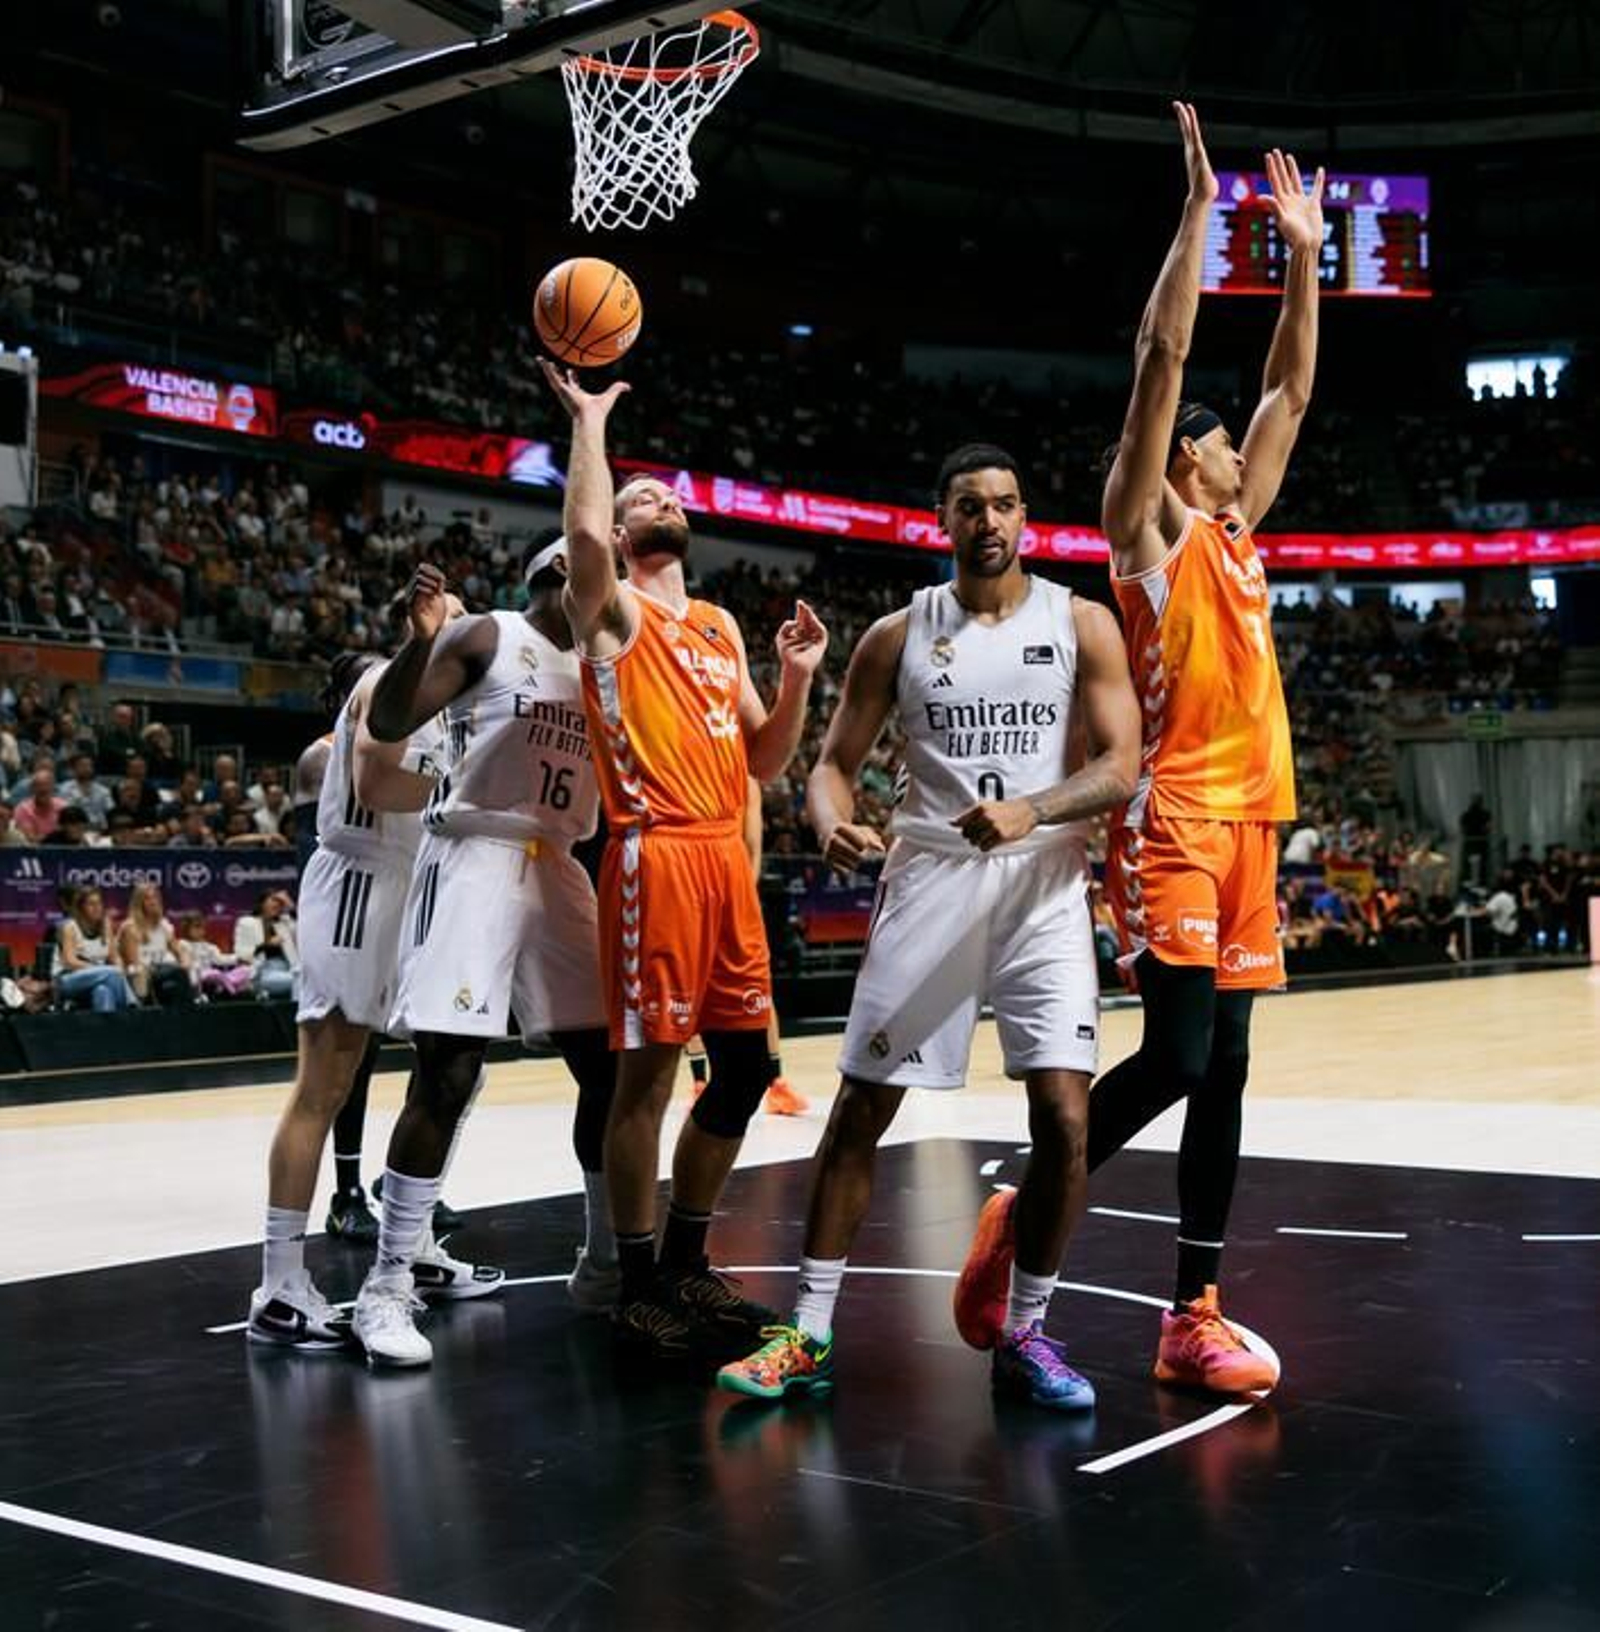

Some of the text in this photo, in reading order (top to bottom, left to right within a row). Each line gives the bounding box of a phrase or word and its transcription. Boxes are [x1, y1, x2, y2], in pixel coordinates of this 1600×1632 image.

[124, 364, 217, 399] VALENCIA
[146, 392, 217, 422] BASKET
[313, 420, 365, 448] acb
[924, 696, 1057, 730] Emirates
[527, 724, 554, 748] FLY
[947, 731, 1040, 757] FLY BETTER
[540, 760, 574, 810] 16
[67, 863, 162, 887] endesa
